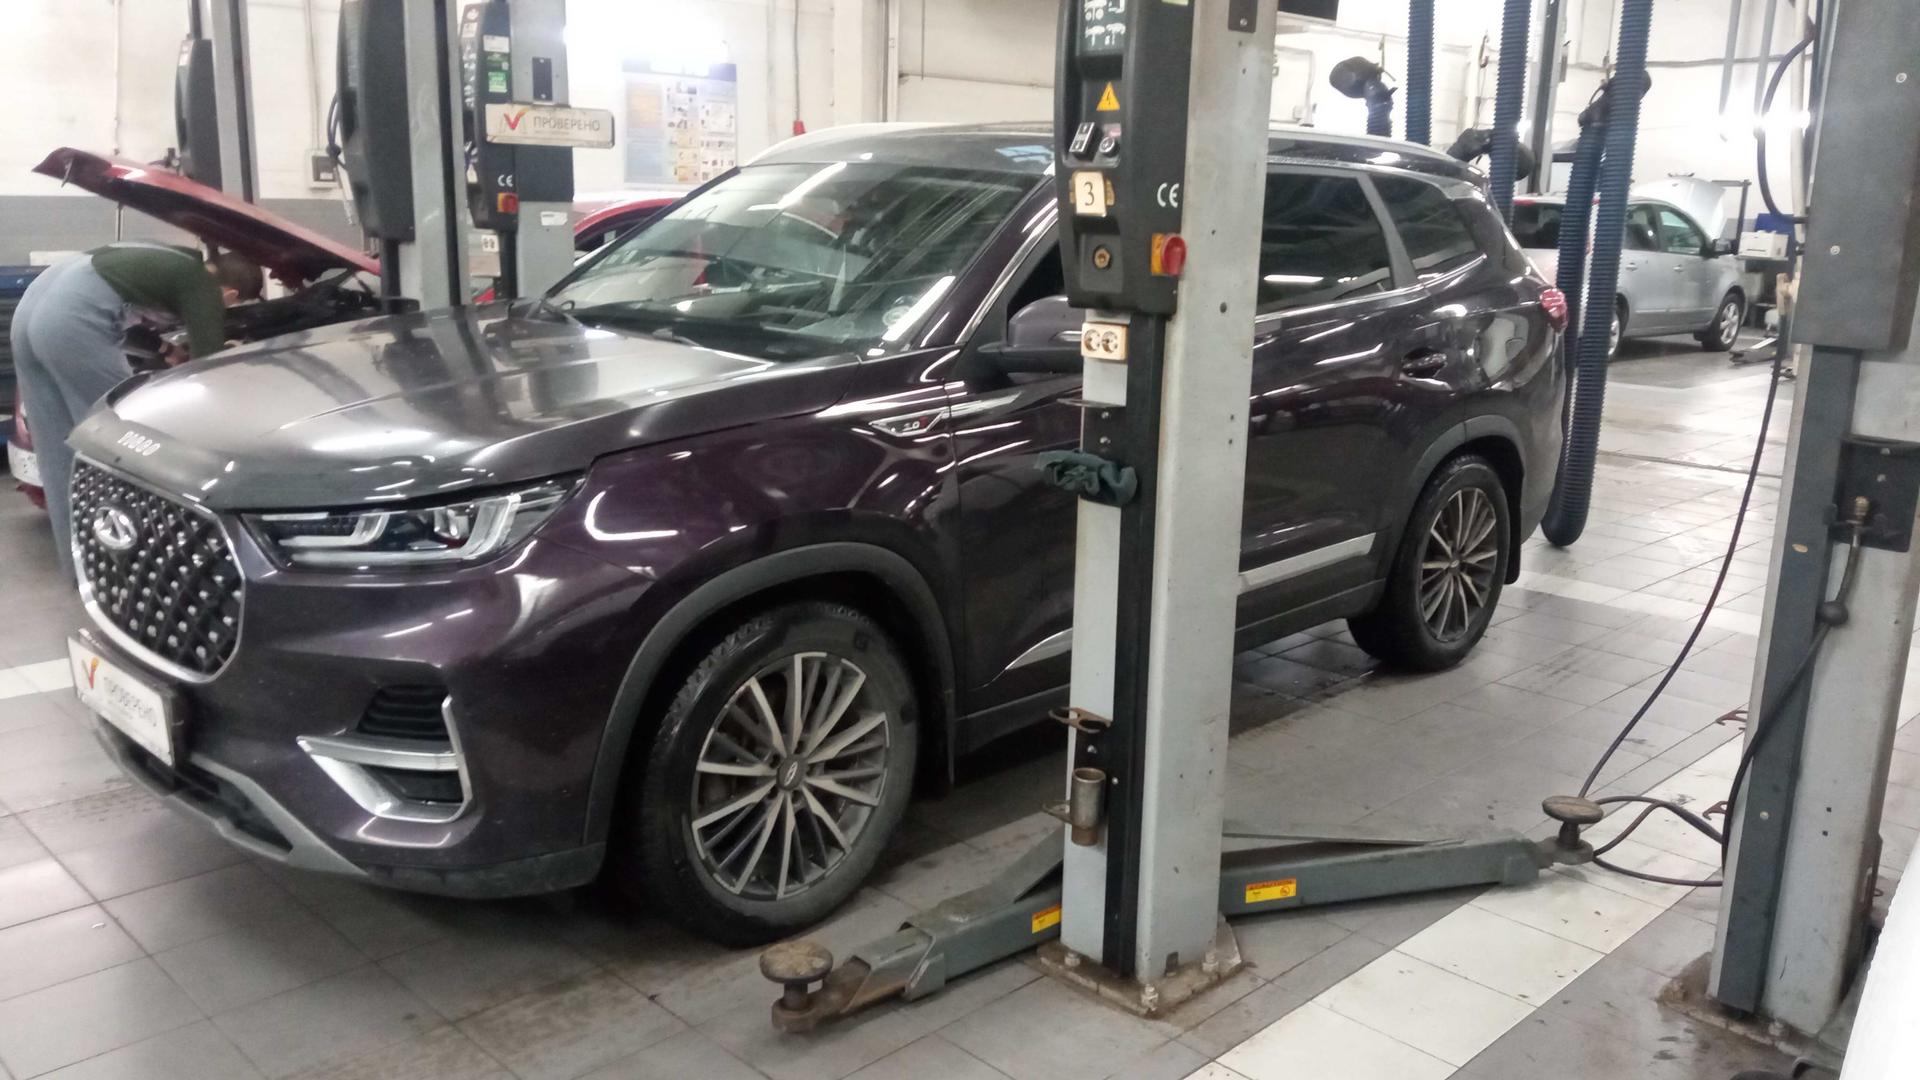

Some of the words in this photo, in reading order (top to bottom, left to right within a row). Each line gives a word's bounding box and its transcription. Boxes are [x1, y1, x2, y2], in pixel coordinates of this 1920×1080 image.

[533, 116, 600, 132] ПРОВЕРЕНО
[497, 174, 513, 187] CE
[1083, 181, 1095, 206] 3
[1157, 182, 1179, 208] CE
